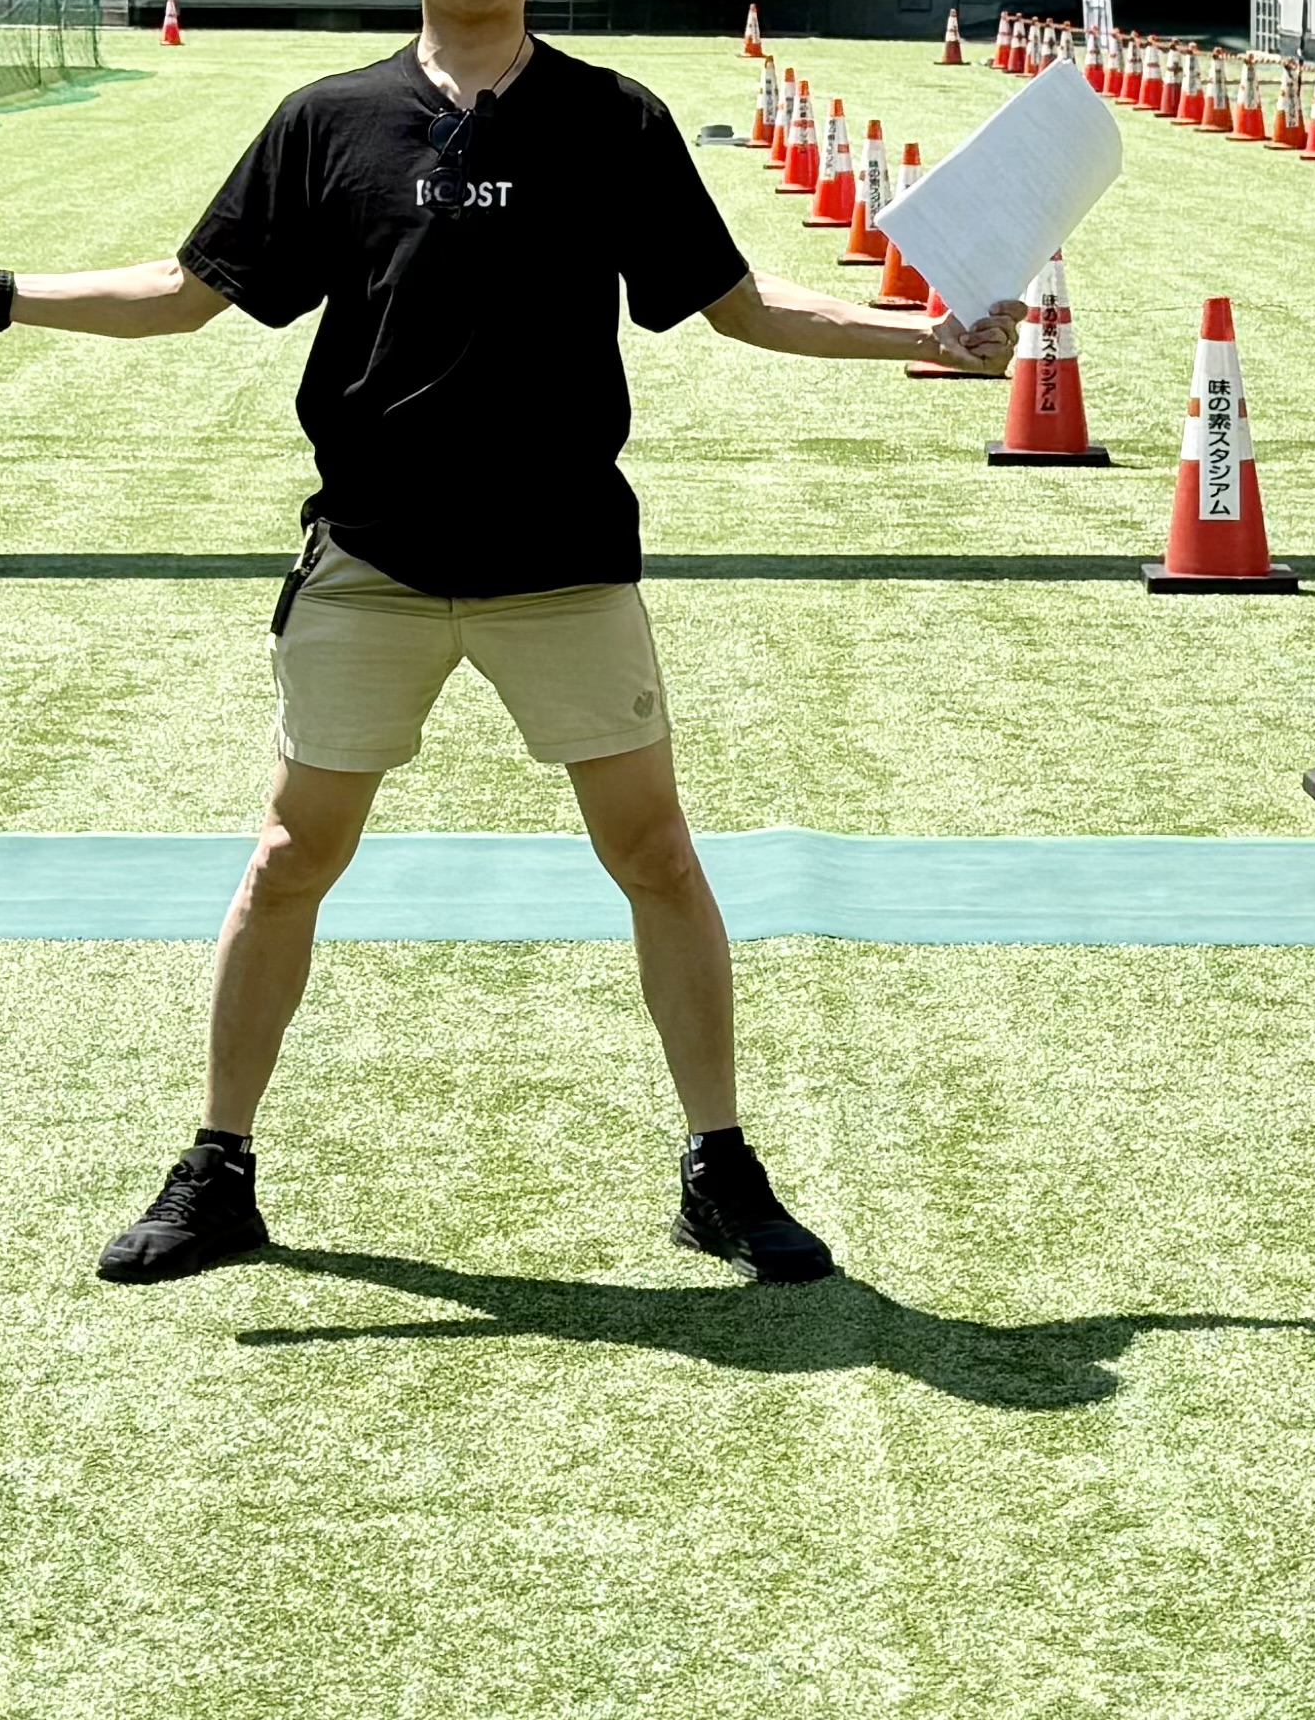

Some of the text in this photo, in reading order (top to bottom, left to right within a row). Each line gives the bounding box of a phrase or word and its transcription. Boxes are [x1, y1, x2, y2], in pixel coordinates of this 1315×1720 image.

[1208, 379, 1232, 516] 味の素スタジアム
